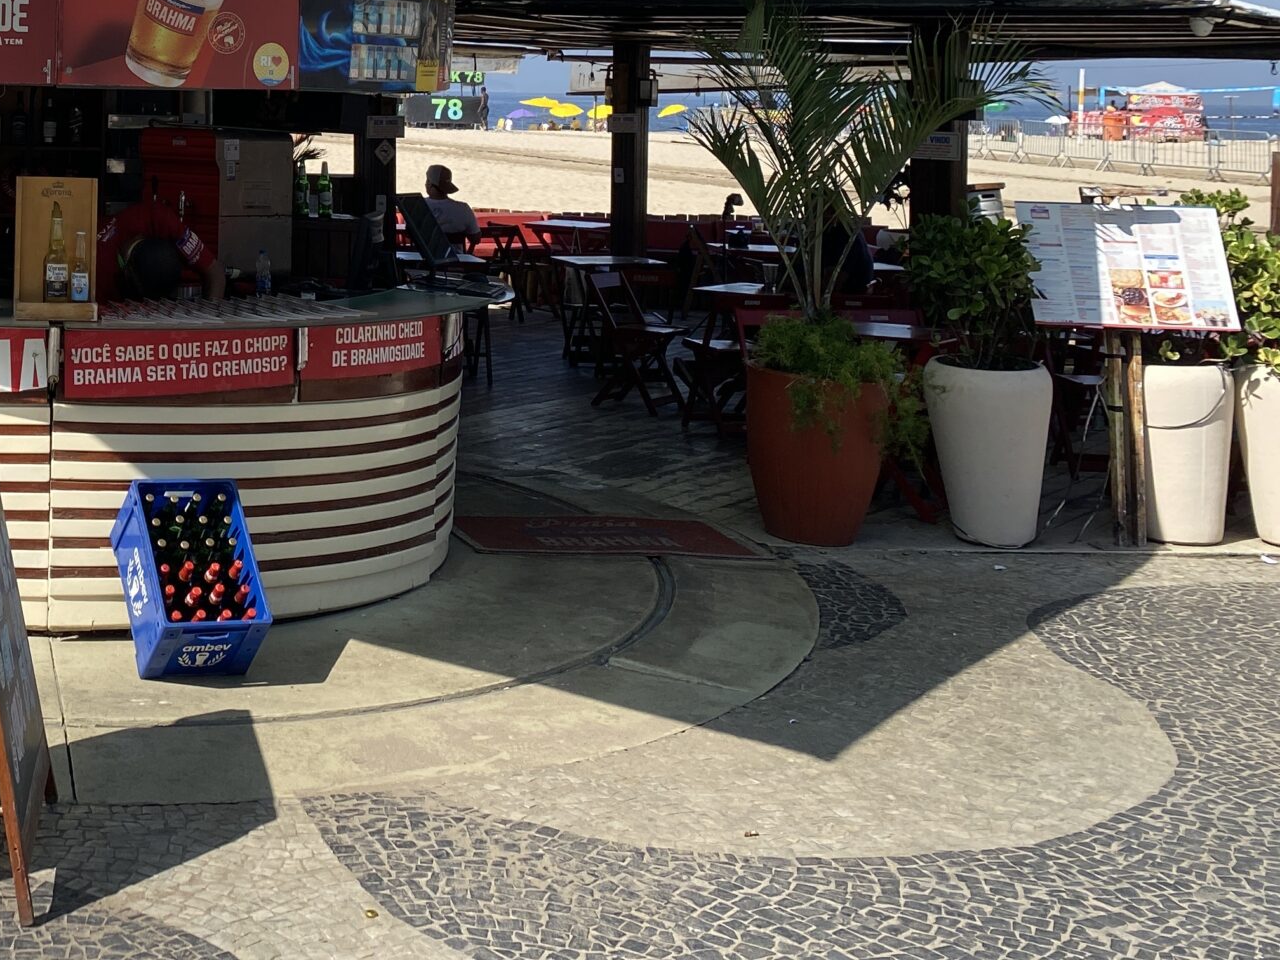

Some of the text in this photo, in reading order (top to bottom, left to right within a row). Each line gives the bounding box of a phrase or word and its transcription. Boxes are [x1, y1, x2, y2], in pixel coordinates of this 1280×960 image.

[431, 98, 463, 120] 78
[335, 321, 424, 344] COLARINHO CHEIO
[71, 334, 288, 364] VOCÊ SABE O QUE FAZ O CHOPP
[332, 342, 425, 368] DE BRAHMOSIDADE
[73, 355, 288, 385] BRAHMA SER TÃO CREMOSO?
[182, 642, 233, 652] ambev
